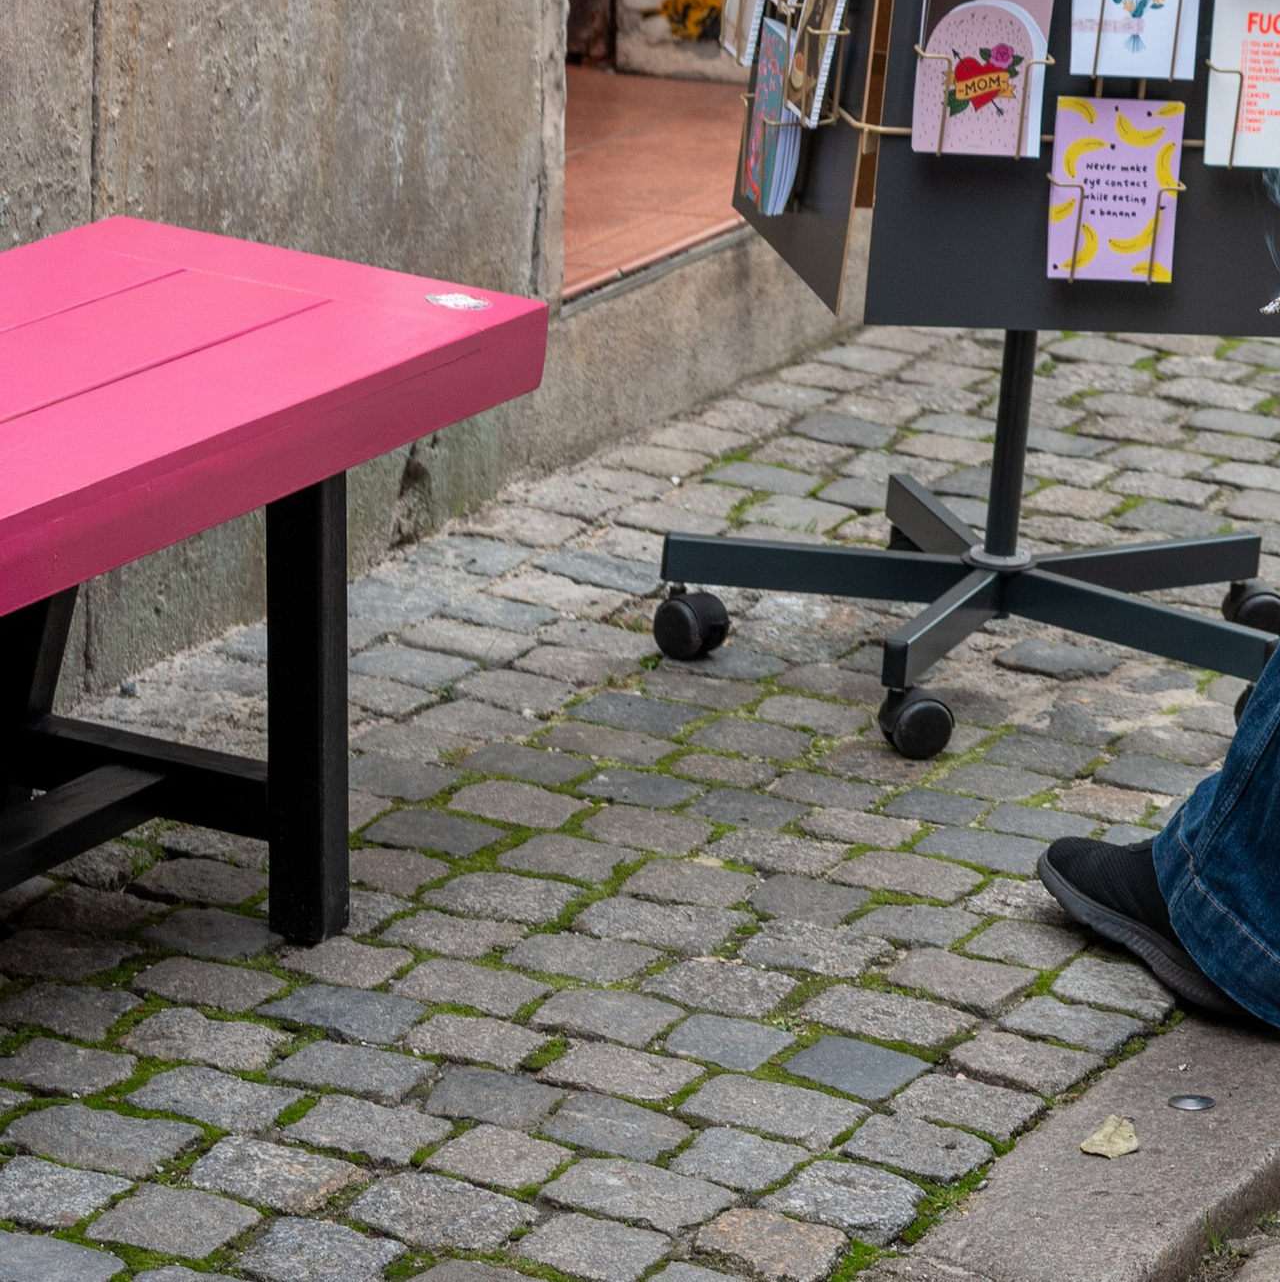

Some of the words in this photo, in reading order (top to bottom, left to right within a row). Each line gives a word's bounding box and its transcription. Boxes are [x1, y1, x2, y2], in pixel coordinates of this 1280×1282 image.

[964, 75, 1001, 95] MOM
[1086, 163, 1116, 171] Never
[1121, 164, 1148, 173] make
[1084, 178, 1101, 189] eye
[1105, 179, 1148, 188] contact
[1083, 193, 1108, 201] while
[1112, 194, 1146, 205] eating
[1100, 209, 1137, 218] banana
